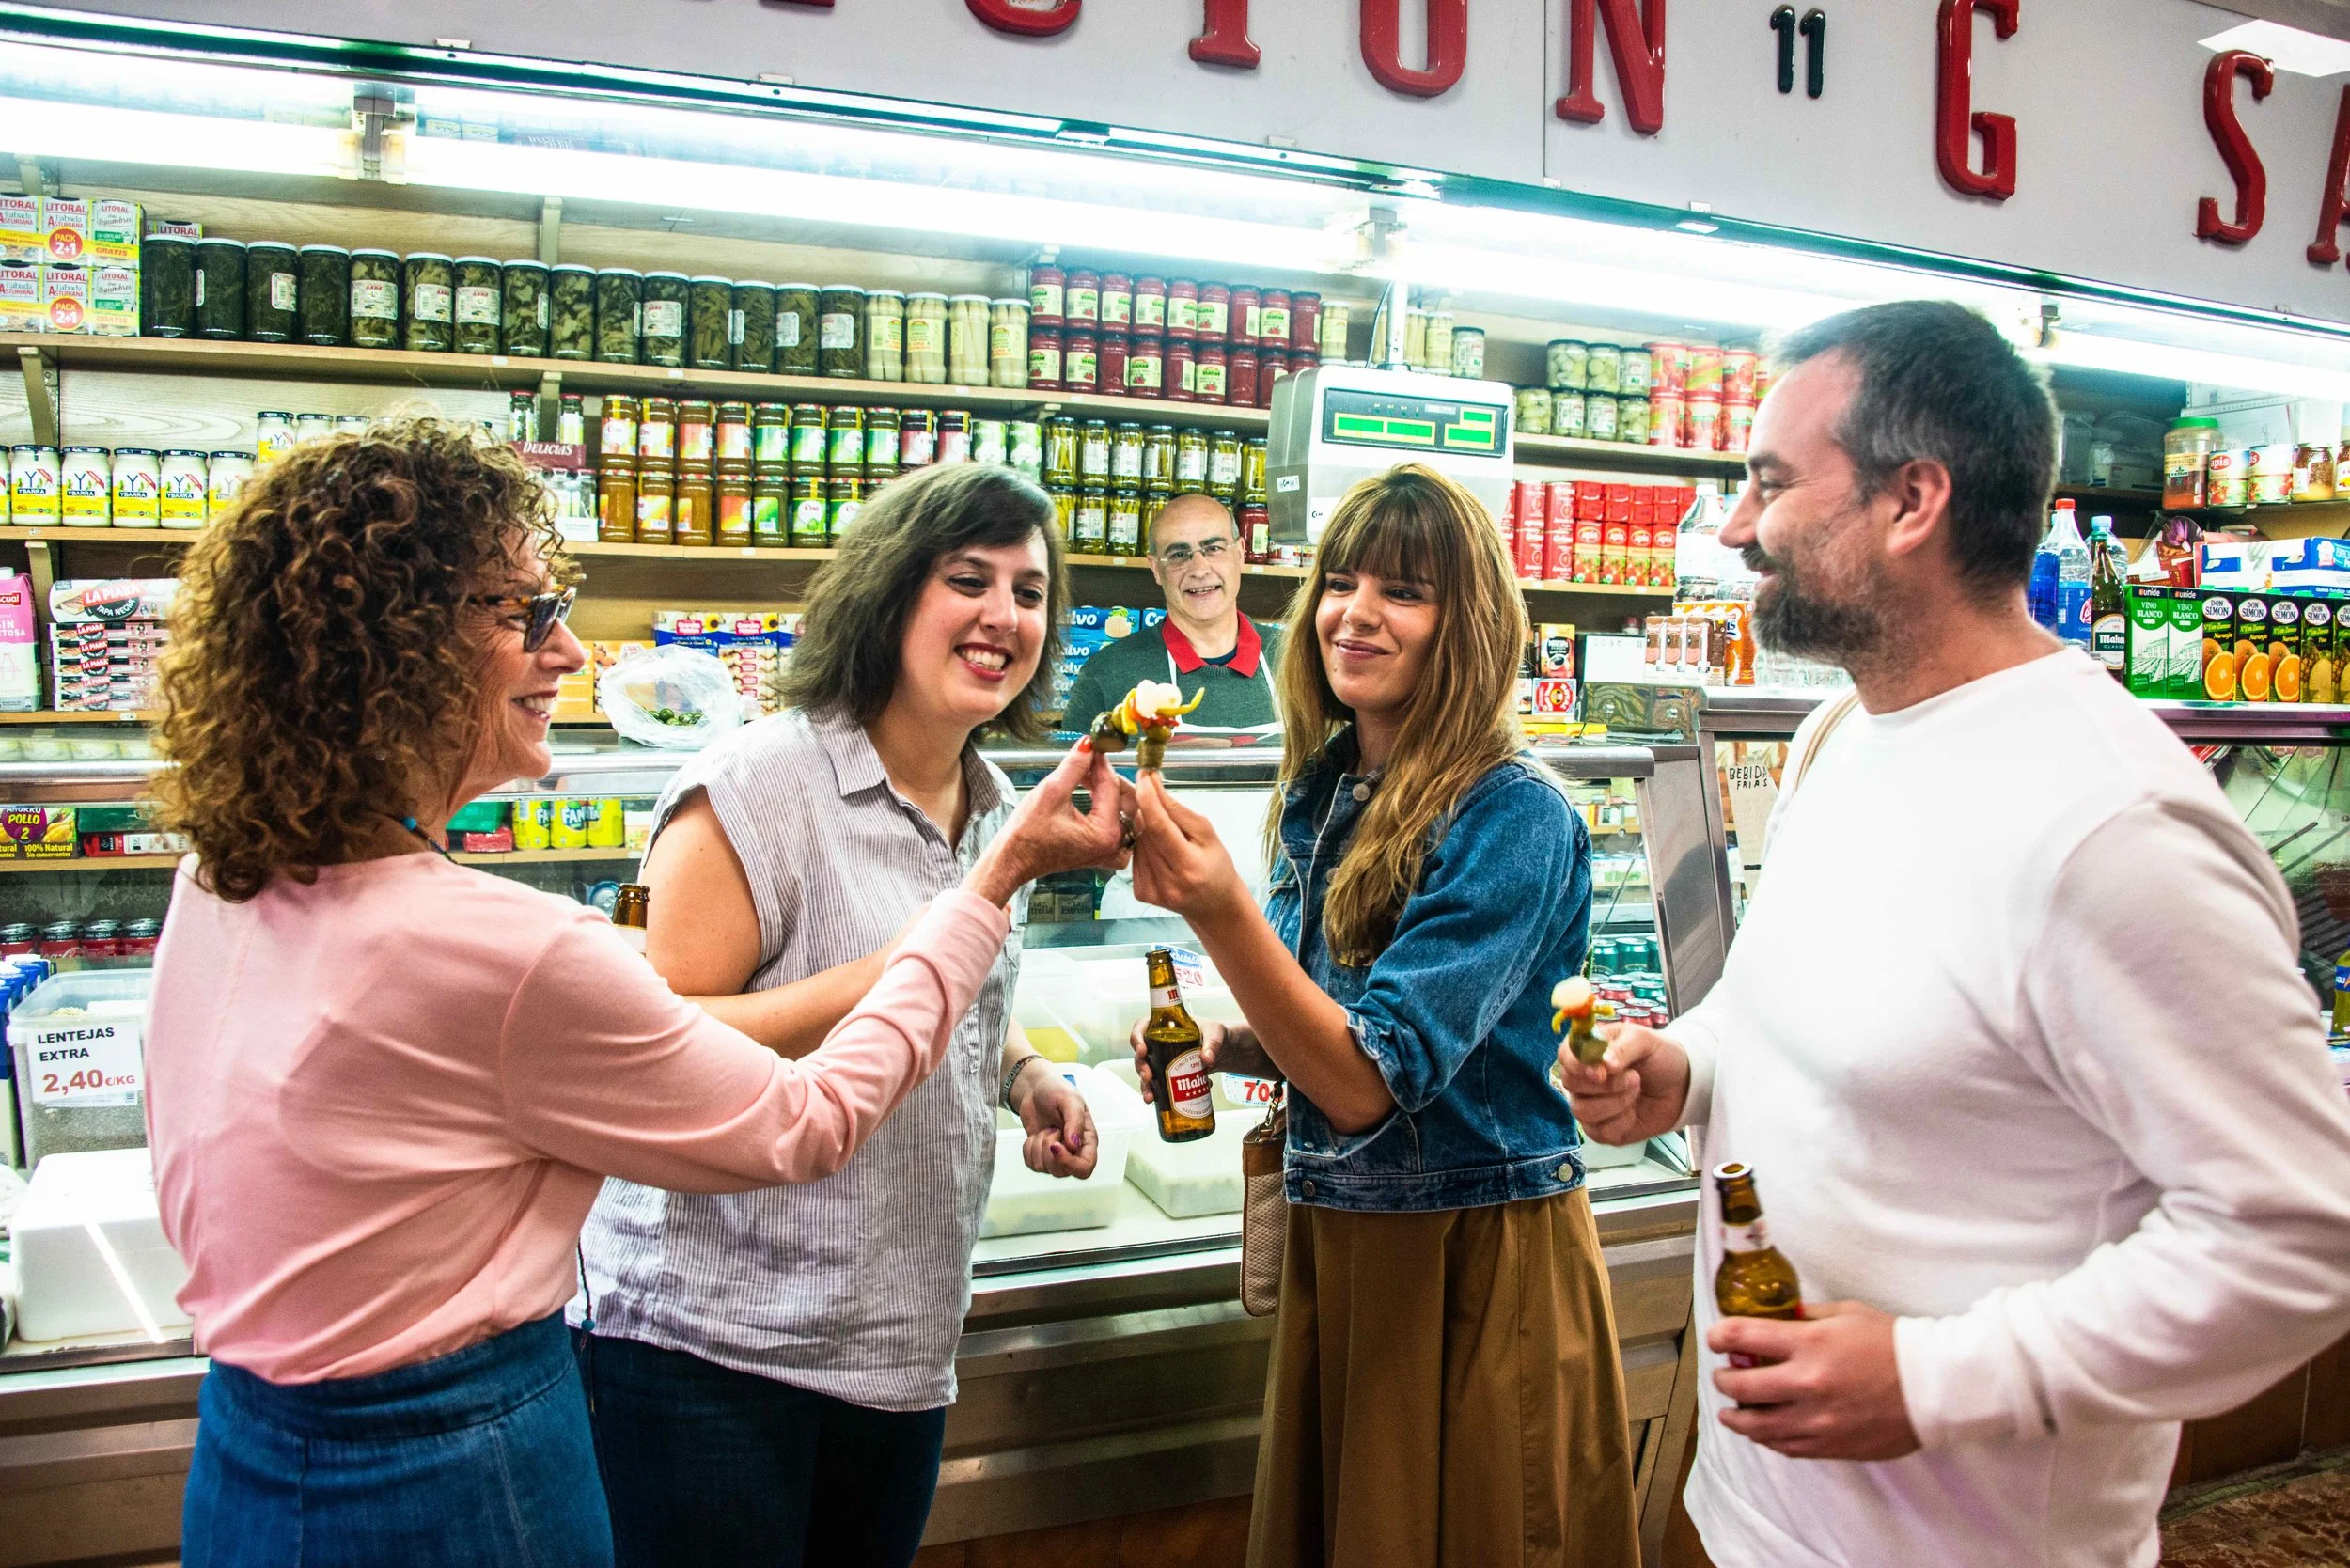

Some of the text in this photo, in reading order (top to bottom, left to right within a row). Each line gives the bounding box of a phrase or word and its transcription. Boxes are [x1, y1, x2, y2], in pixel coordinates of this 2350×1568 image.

[0, 198, 36, 210] ITORAL
[45, 202, 87, 213] LITORAL
[102, 205, 130, 213] LITORAL
[55, 233, 76, 242] PACK
[55, 242, 77, 255] 2+1
[0, 270, 37, 279] ITORAL
[46, 272, 86, 281] LITORAL
[55, 303, 76, 311] PACK
[56, 311, 77, 324] 2+1
[522, 442, 573, 456] DELICIAS
[2210, 458, 2230, 469] apis
[86, 585, 140, 604] LA PIARA
[2143, 588, 2161, 597] unide
[2179, 590, 2197, 599] unide
[96, 598, 136, 617] TAPA NEGRA
[2205, 606, 2229, 617] SIMON
[2137, 609, 2163, 619] BLANCO
[2172, 612, 2199, 620] BLANCO
[2241, 608, 2264, 618] SIMON
[2274, 610, 2296, 620] SIMON
[2307, 612, 2327, 621] SIMON
[86, 623, 104, 633] PIARA
[89, 641, 108, 651] PIARA
[90, 659, 109, 668] PIARA
[1737, 777, 1767, 790] FRIAS
[8, 814, 40, 824] POLLO
[20, 827, 30, 840] 2
[45, 843, 73, 852] Natural
[1061, 905, 1092, 915] Estrella
[38, 1027, 115, 1044] LENTEJAS
[39, 1047, 90, 1062] EXTRA
[1175, 1058, 1189, 1071] CINCO
